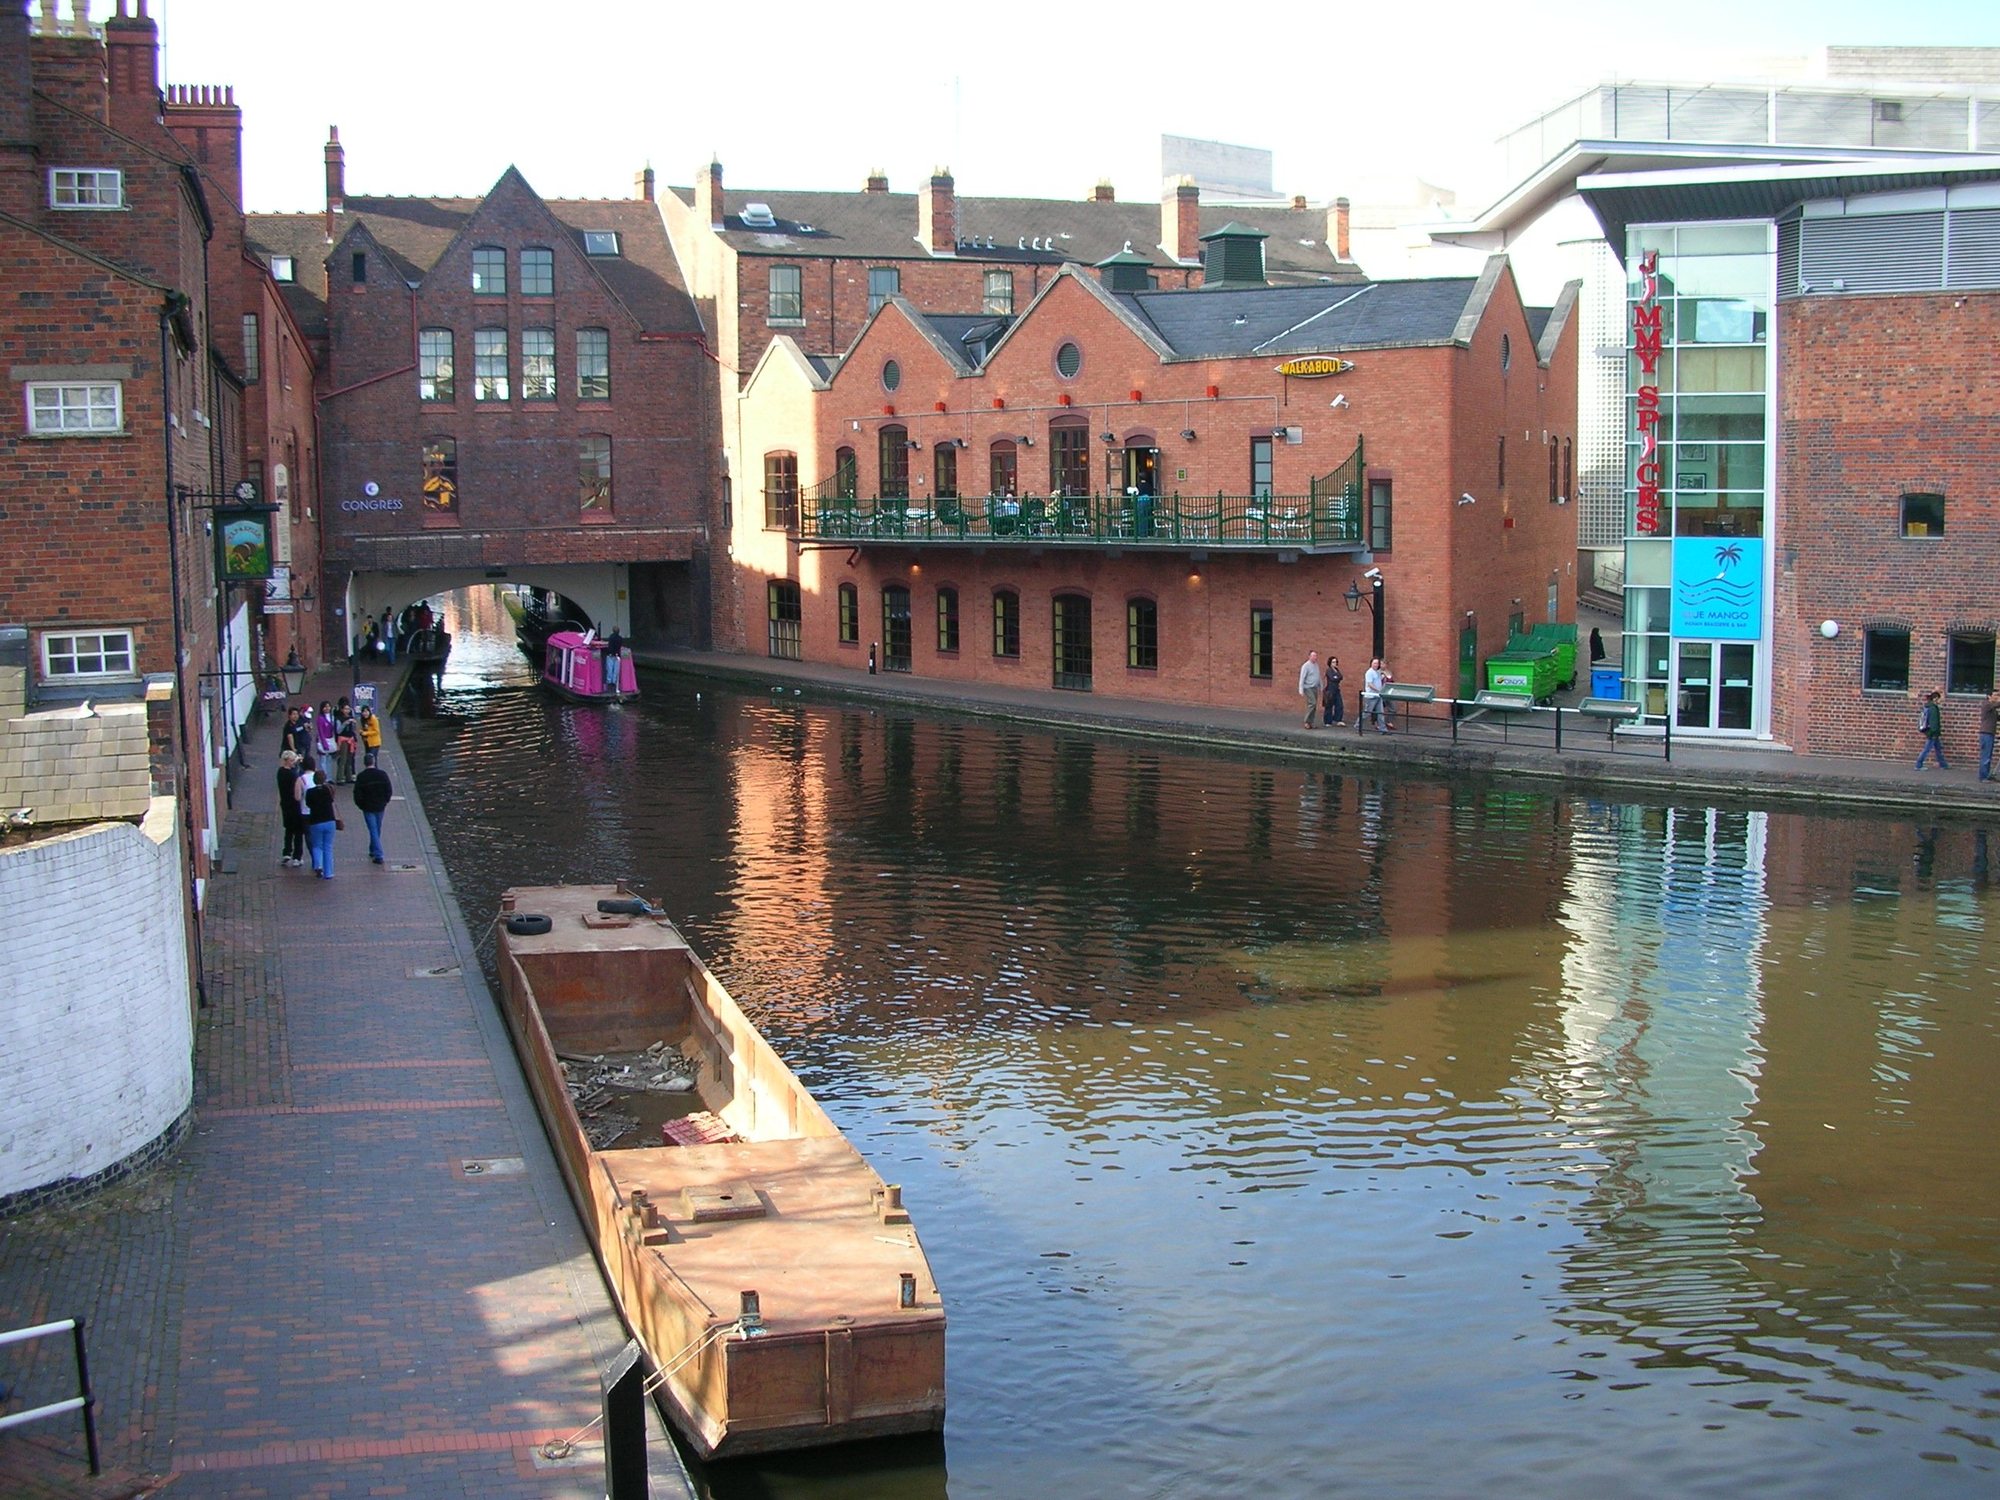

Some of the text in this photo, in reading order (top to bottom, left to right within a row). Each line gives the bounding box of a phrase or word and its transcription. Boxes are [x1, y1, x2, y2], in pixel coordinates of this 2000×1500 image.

[341, 499, 403, 511] CONGRESS
[1708, 611, 1749, 620] MANGO
[264, 691, 286, 700] OPEN
